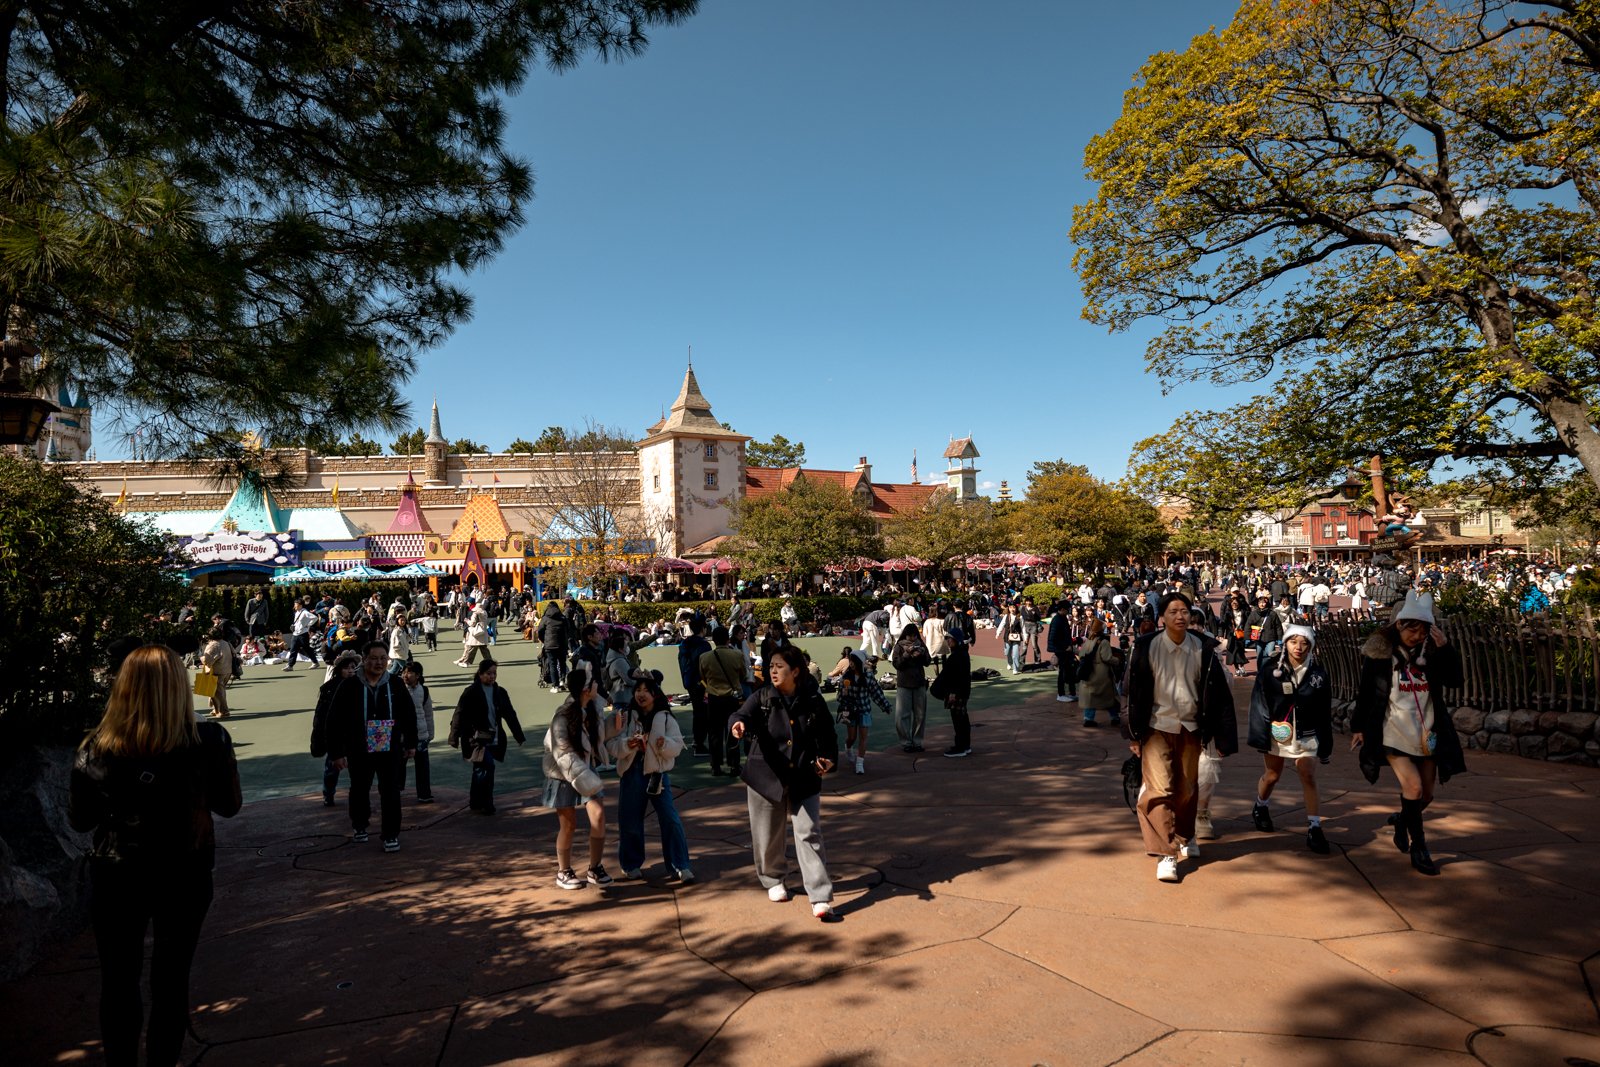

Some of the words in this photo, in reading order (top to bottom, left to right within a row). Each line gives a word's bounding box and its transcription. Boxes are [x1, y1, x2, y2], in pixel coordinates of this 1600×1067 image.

[1374, 537, 1396, 545] SPLASH
[191, 545, 214, 556] Peter
[214, 543, 239, 554] Pan's
[239, 543, 267, 554] Flight
[1372, 542, 1399, 550] MOUNTAIN
